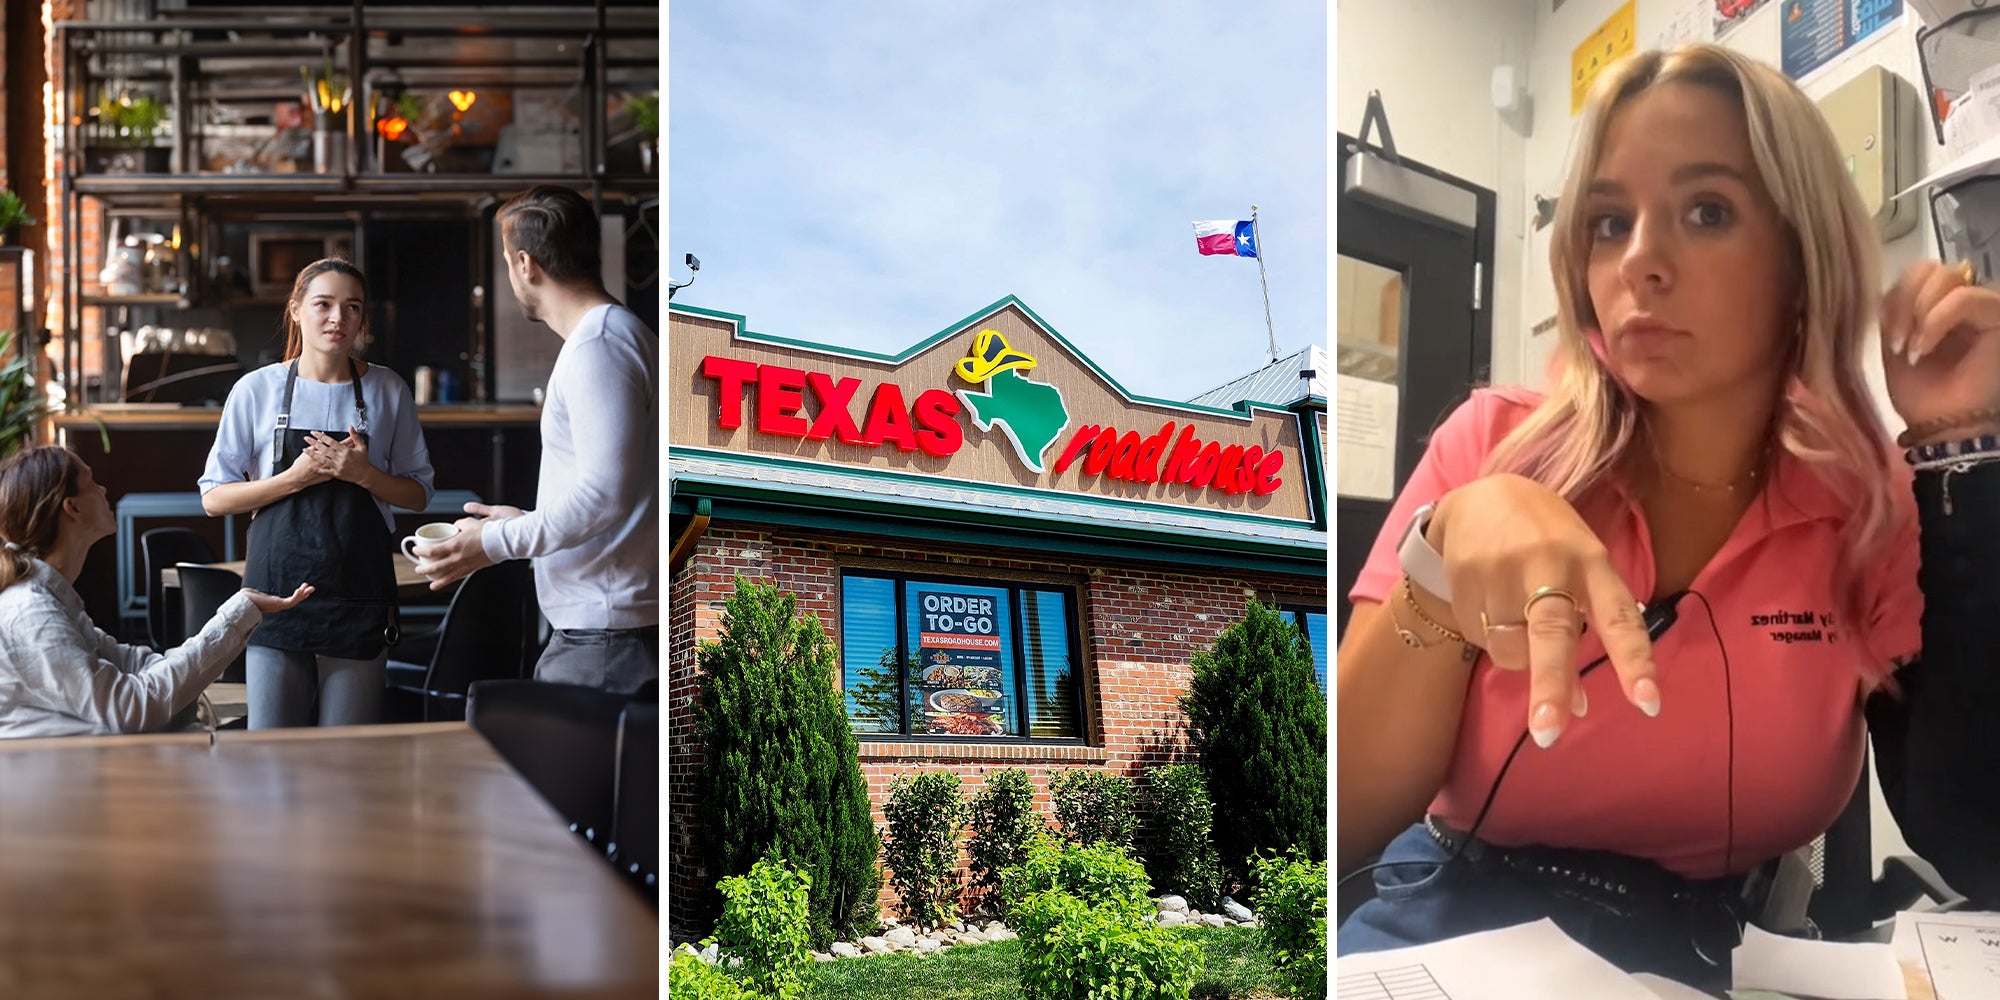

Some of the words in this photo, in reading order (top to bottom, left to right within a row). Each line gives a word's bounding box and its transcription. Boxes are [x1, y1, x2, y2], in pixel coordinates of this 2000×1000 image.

[702, 355, 964, 457] TEXAS
[924, 594, 993, 616] ORDER
[925, 613, 993, 635] TO-GO
[922, 636, 999, 647] TEXASROADHOUSE.COM
